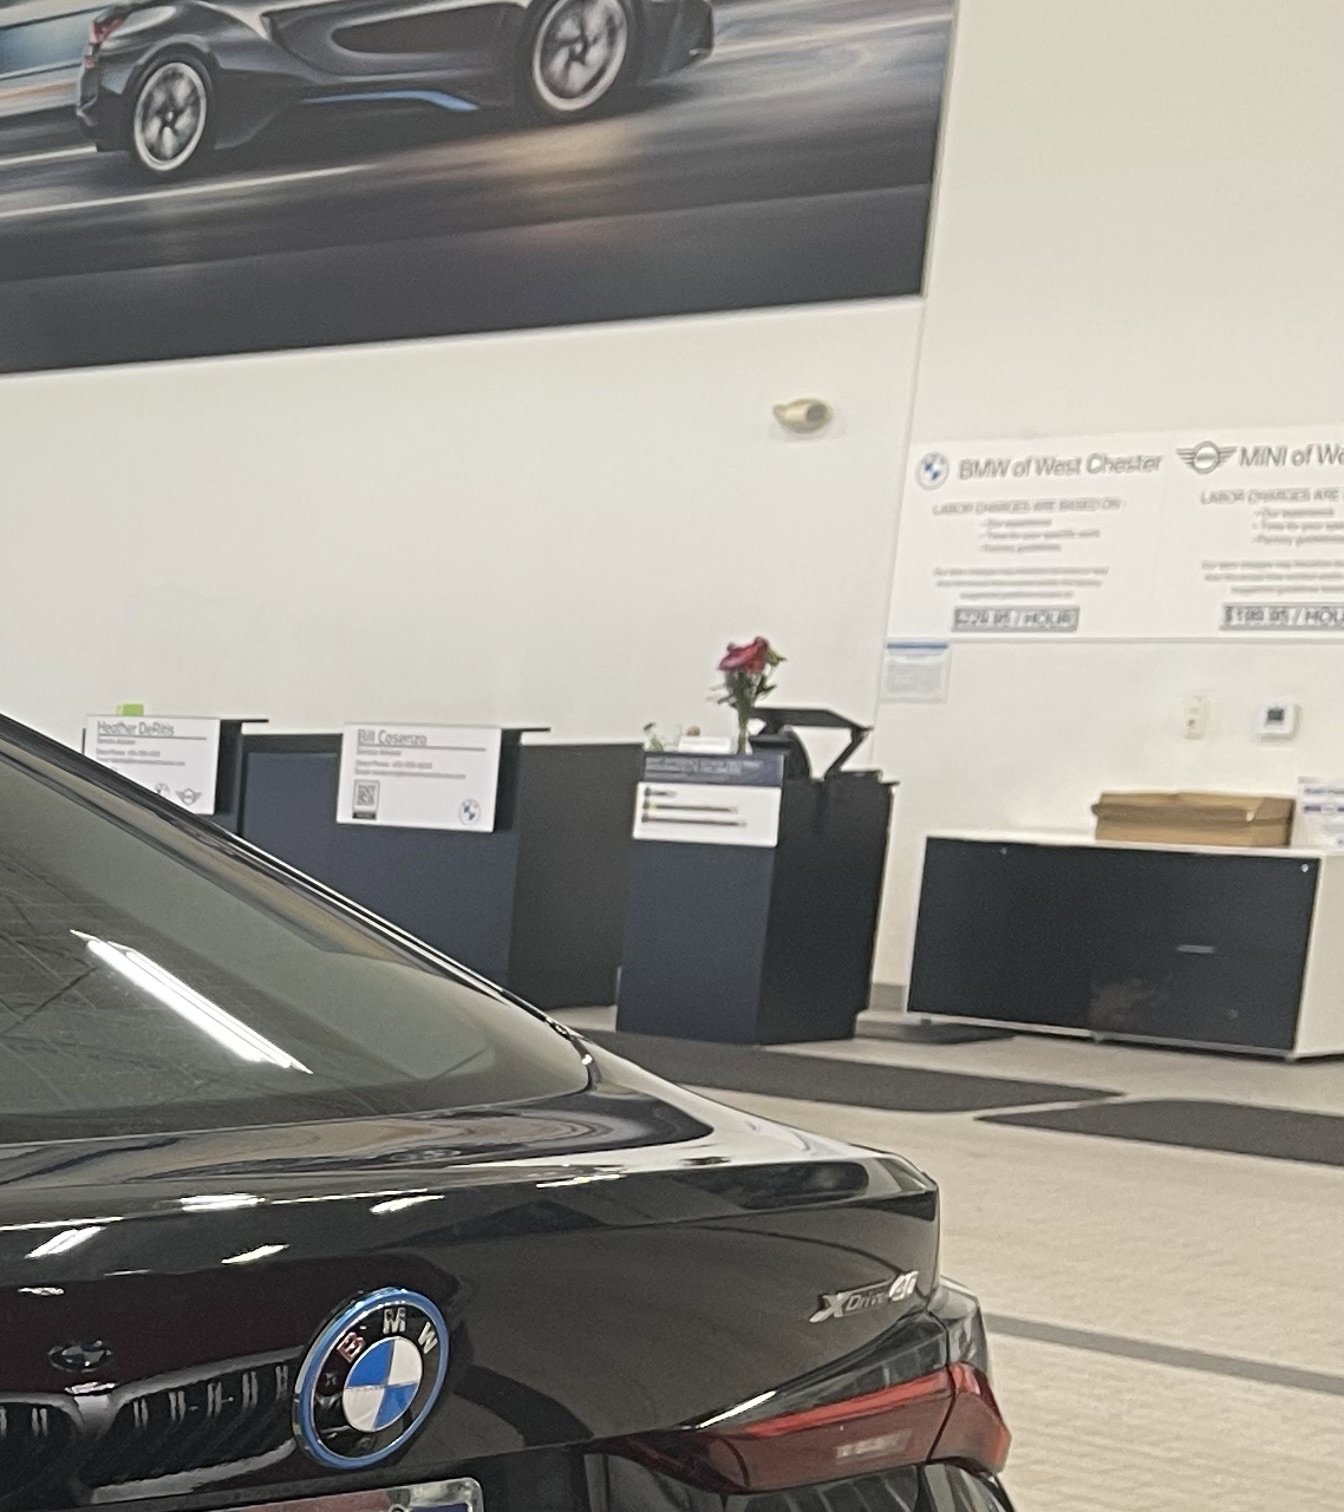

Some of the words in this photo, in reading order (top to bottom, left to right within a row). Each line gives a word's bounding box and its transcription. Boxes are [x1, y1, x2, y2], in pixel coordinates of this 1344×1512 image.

[958, 457, 1010, 480] BMW
[1012, 456, 1032, 478] of
[1035, 455, 1082, 476] West
[1086, 453, 1164, 474] Chester
[1239, 447, 1288, 467] MINI
[1291, 444, 1314, 467] of
